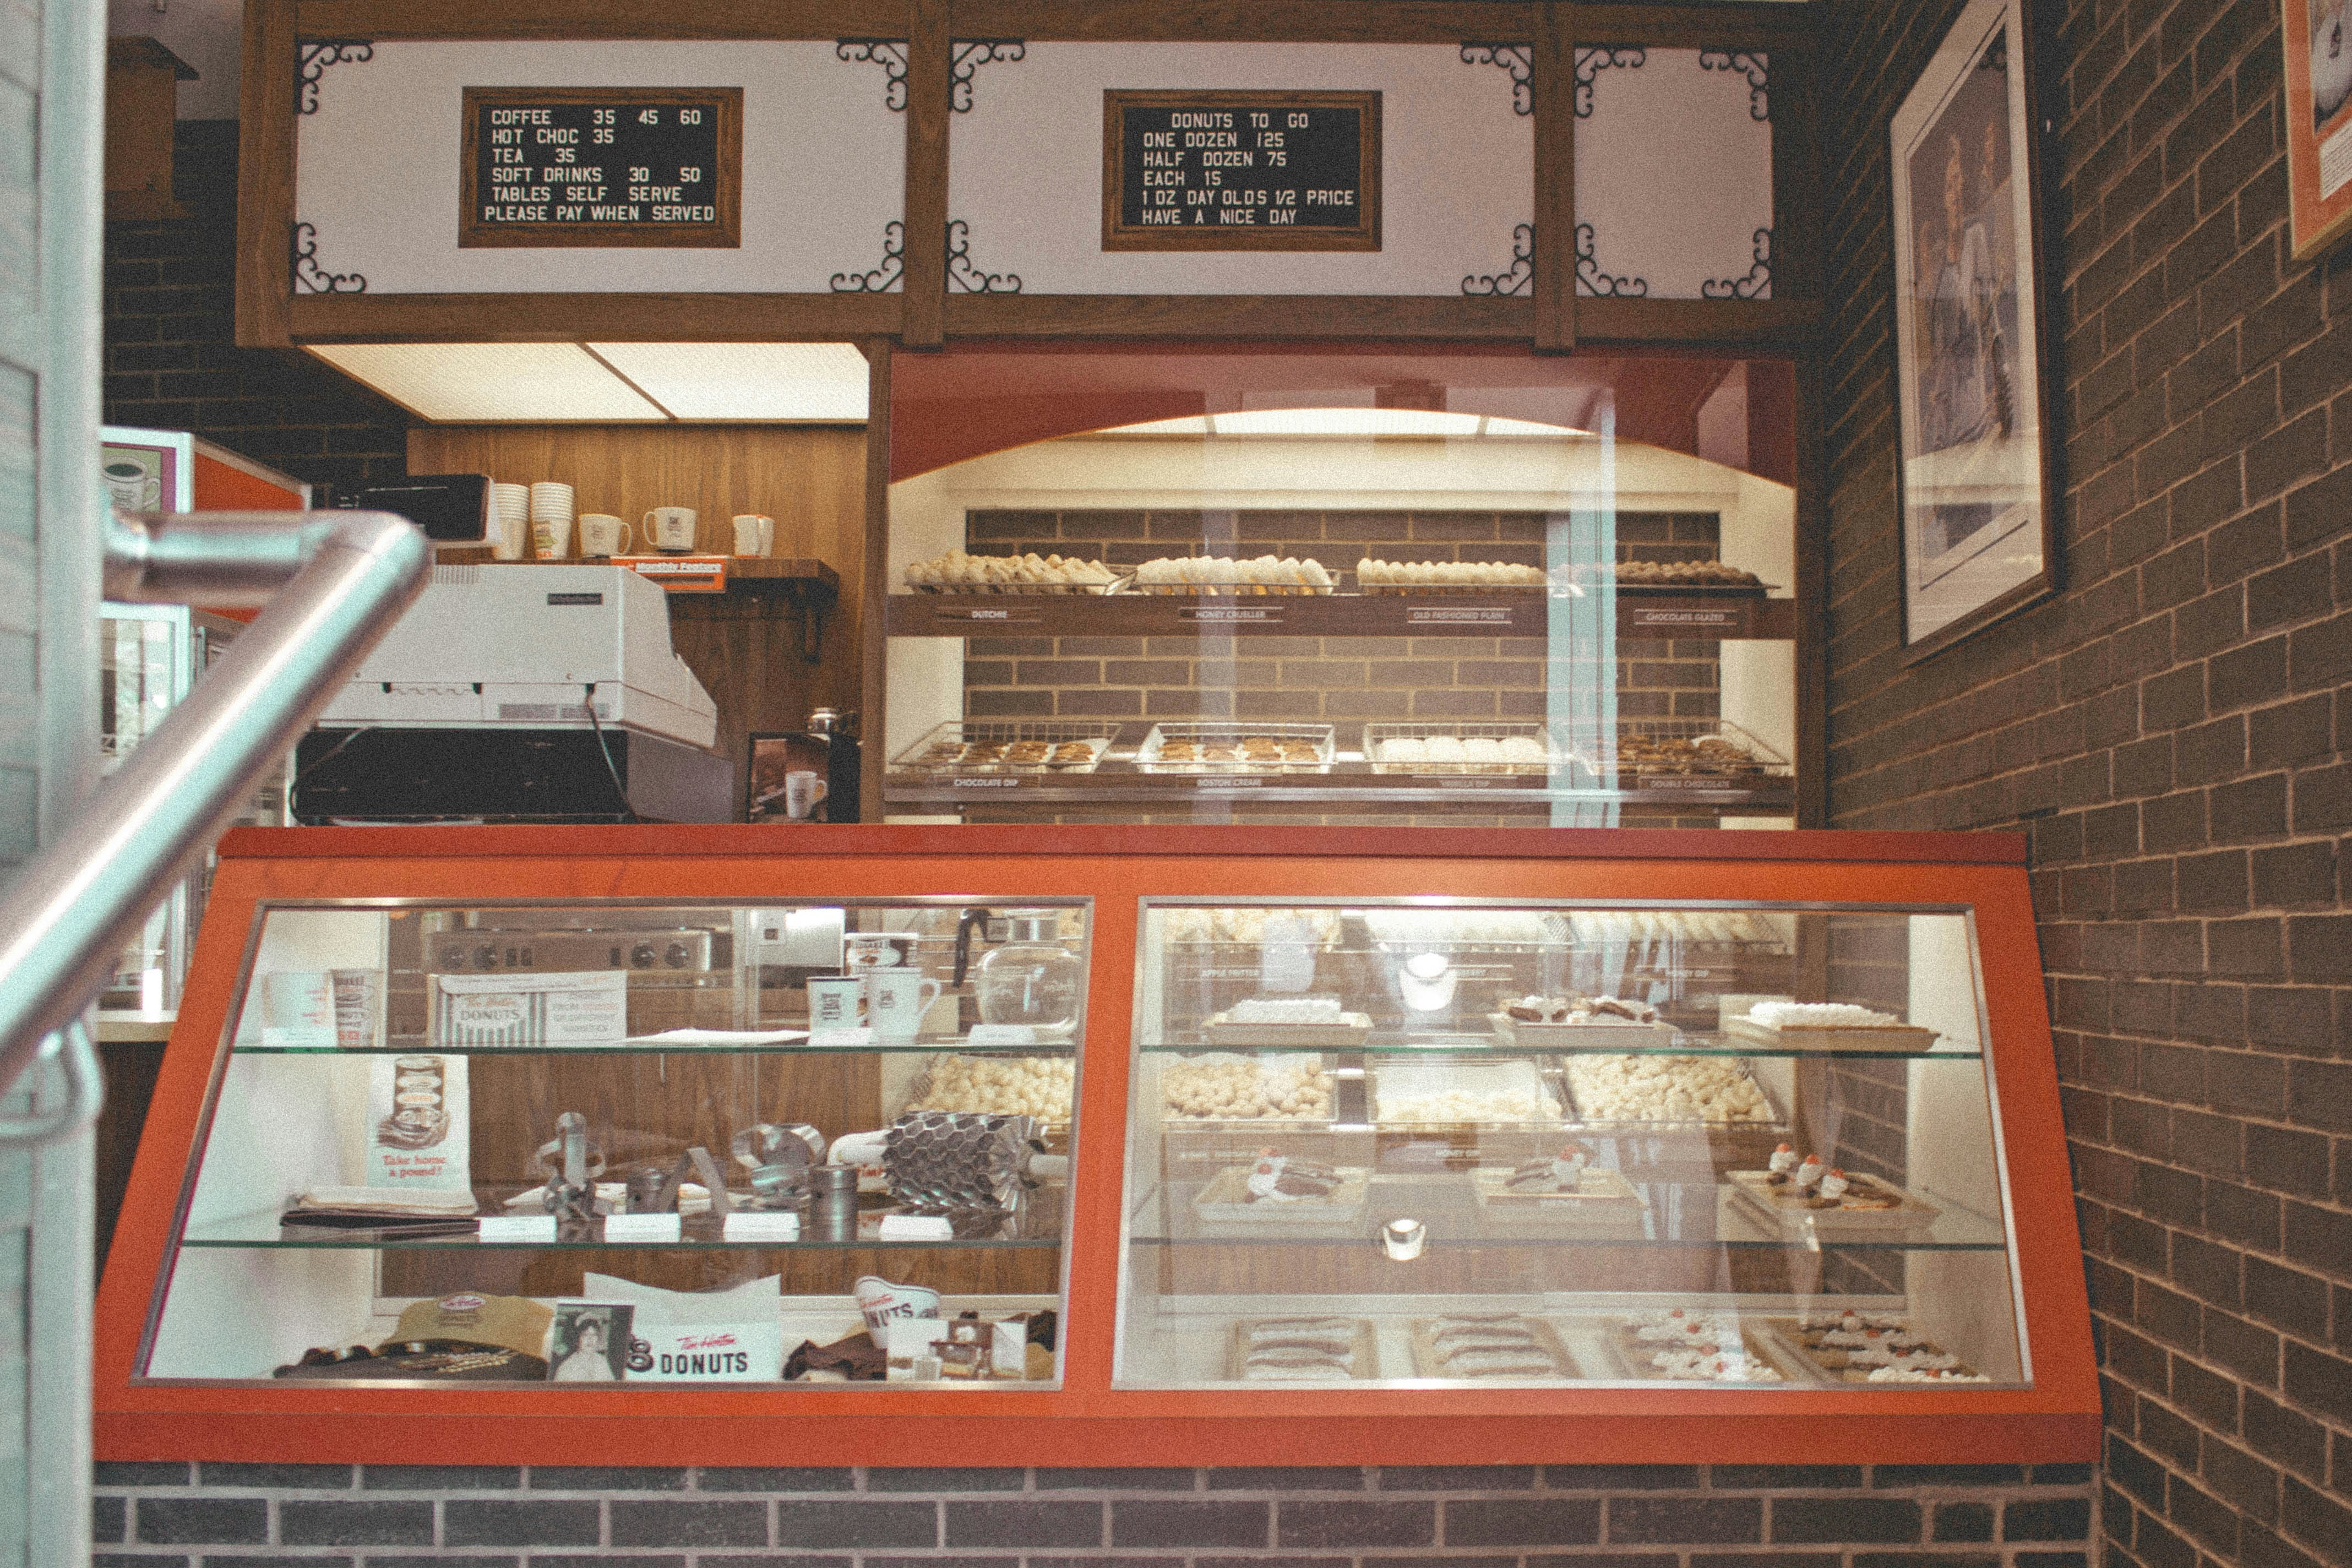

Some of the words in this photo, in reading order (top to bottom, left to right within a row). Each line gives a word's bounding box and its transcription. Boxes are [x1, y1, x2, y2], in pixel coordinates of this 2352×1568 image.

[492, 110, 551, 125] COFFEE
[594, 110, 615, 124] 35
[639, 110, 658, 124] 45
[680, 110, 701, 125] 60
[1172, 113, 1233, 128] DONUTS
[1250, 113, 1268, 128] TO
[1288, 113, 1308, 128] GO
[492, 129, 524, 144] HOT
[537, 128, 579, 144] CHOC
[594, 128, 614, 144] 35
[1144, 132, 1175, 148] ONE
[1185, 132, 1237, 148] DOZEN
[1257, 132, 1284, 147] 125
[493, 148, 524, 163] TEA
[556, 148, 575, 163] 35
[1144, 151, 1185, 167] HALF
[1203, 151, 1253, 166] DOZEN
[1267, 151, 1286, 166] 75
[493, 167, 533, 182] SOFT
[544, 167, 602, 182] DRINKS
[629, 167, 649, 182] 30
[680, 167, 700, 183] 50
[1144, 171, 1185, 186] EACH
[1205, 171, 1221, 186] 15
[492, 186, 551, 202] TABLES
[567, 186, 608, 202] SELF
[629, 186, 682, 202] SERVE
[1156, 190, 1176, 205] OZ
[1187, 190, 1215, 205] DAY
[1222, 190, 1266, 205] OLDS
[1276, 190, 1295, 205] 1/2
[1307, 190, 1353, 205] PRICE
[485, 205, 547, 221] PLEASE
[557, 205, 583, 220] PAY
[591, 205, 639, 220] WHEN
[652, 205, 714, 221] SERVED
[1142, 209, 1181, 224] HAVE
[1195, 209, 1204, 224] A
[1220, 209, 1255, 224] NICE
[1270, 209, 1297, 224] DAY
[954, 778, 1001, 787] CHOCOLATE
[1003, 778, 1018, 787] DIP
[1197, 778, 1231, 787] BOSTON
[1233, 778, 1262, 787] CREAM
[461, 1009, 520, 1020] DONUTS
[381, 1154, 410, 1166] Take
[414, 1154, 447, 1164] home
[661, 1352, 748, 1374] DONUTS
